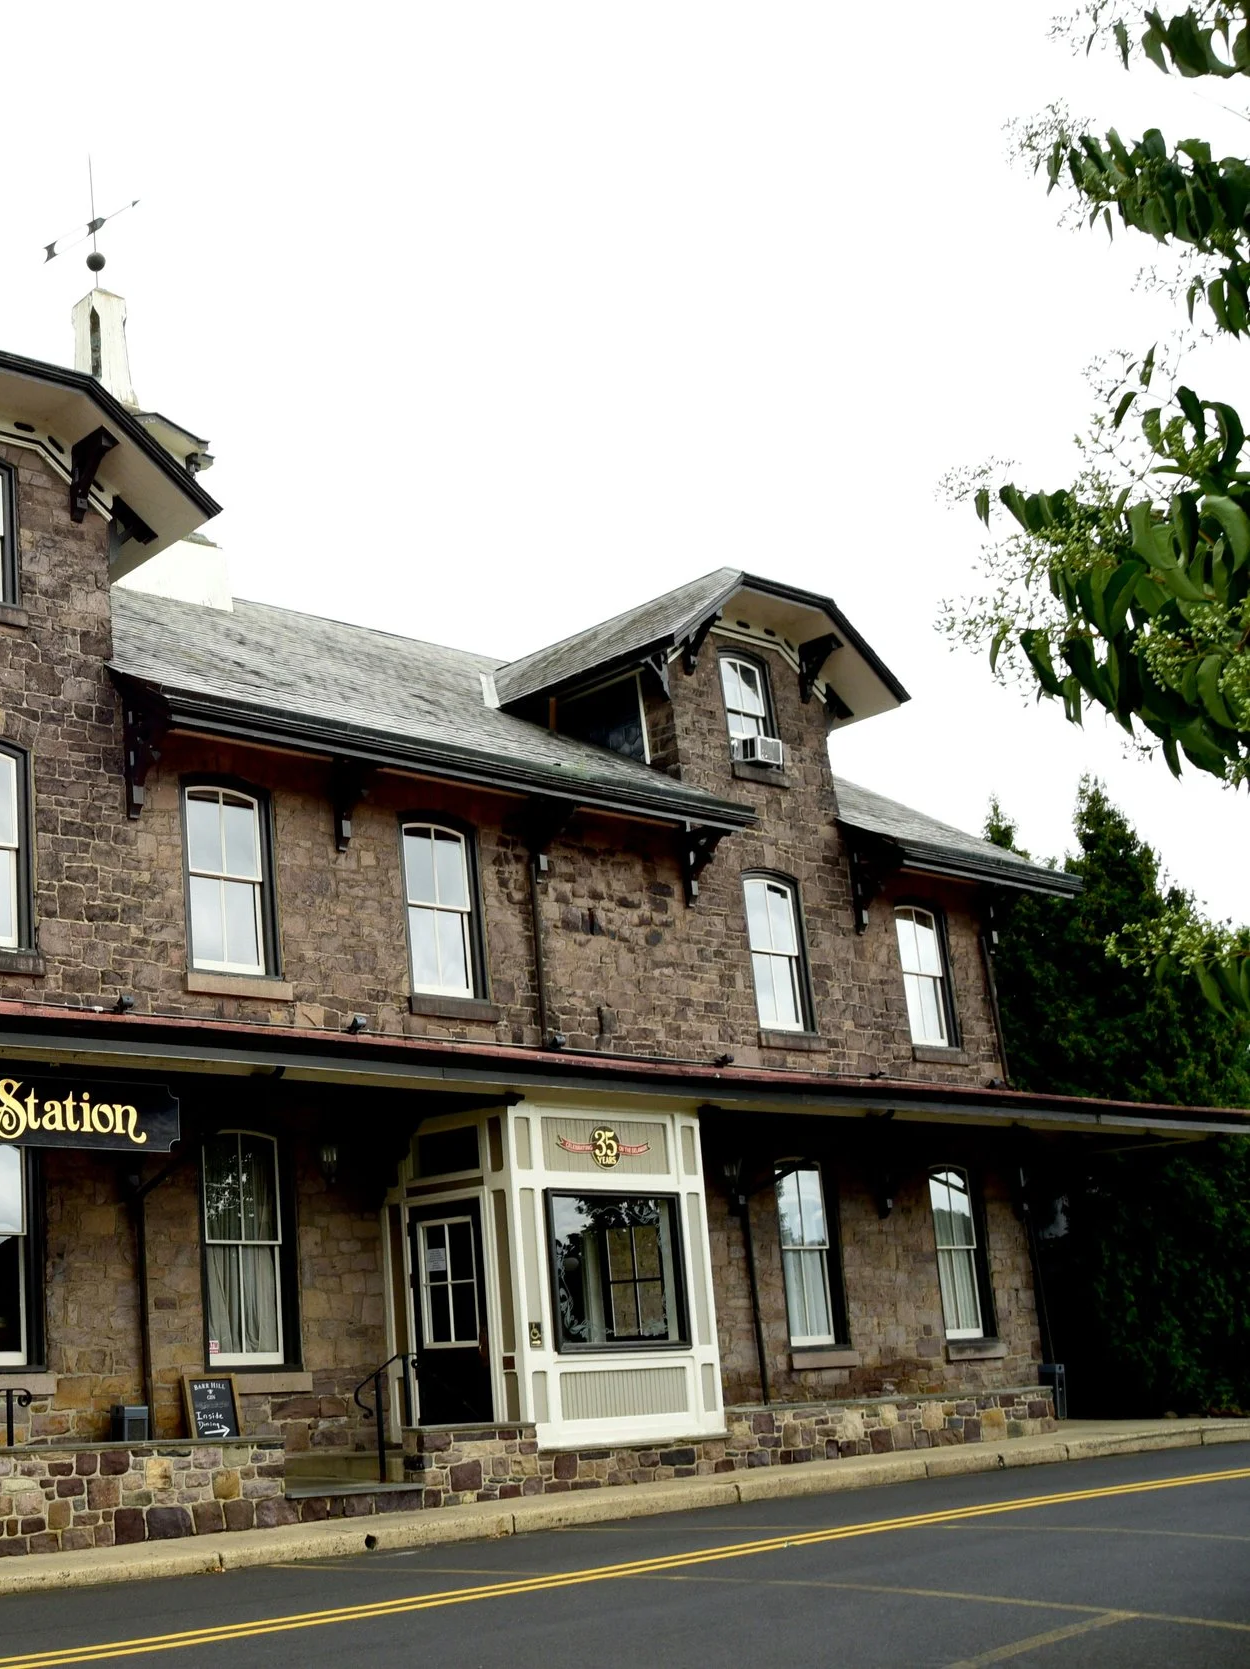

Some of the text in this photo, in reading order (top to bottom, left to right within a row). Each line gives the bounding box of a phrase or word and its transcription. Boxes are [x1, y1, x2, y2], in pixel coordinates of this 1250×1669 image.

[594, 1130, 618, 1156] 35
[597, 1156, 617, 1165] YEARS
[193, 1382, 226, 1391] BARR HILL
[195, 1411, 224, 1420] Inside
[197, 1421, 220, 1431] Dining
